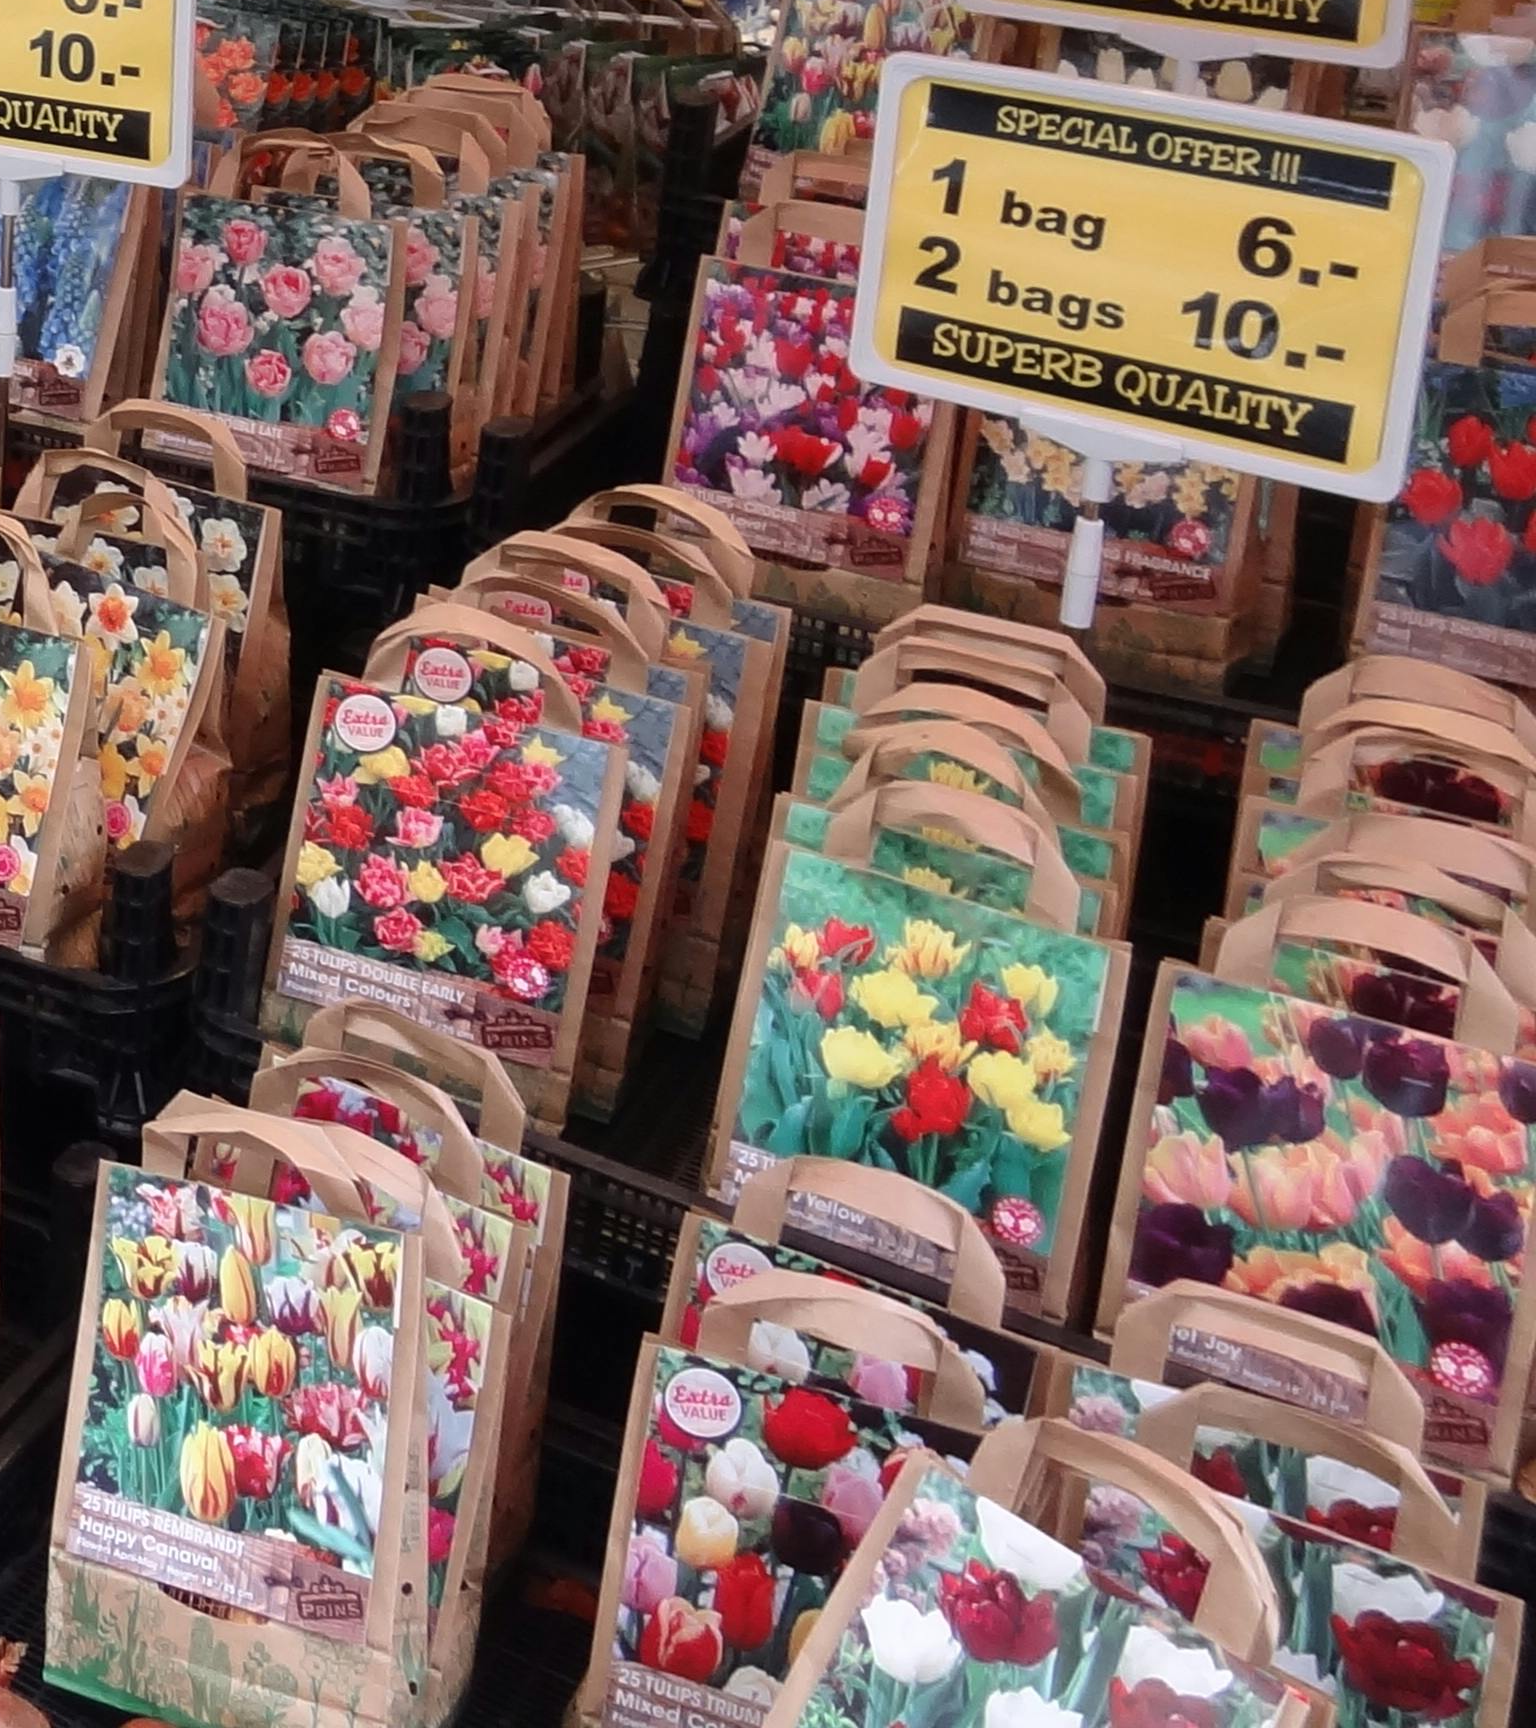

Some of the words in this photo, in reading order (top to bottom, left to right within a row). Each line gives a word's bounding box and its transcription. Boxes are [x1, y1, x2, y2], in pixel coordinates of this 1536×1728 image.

[29, 29, 140, 87] 10.-
[995, 105, 1137, 154] SPECIAL
[1145, 132, 1260, 176] OFFER
[1270, 151, 1301, 183] !!!
[931, 158, 968, 215] 1
[1000, 190, 1107, 251] bag
[1236, 216, 1359, 286] 6.-
[913, 236, 962, 295] 2
[986, 270, 1126, 330] bags
[1180, 291, 1347, 369] 10.-
[932, 324, 1102, 388] SUPERB
[1114, 365, 1313, 438] QUALITY
[417, 662, 465, 680] Extra
[424, 675, 463, 691] VALUE
[341, 709, 389, 727] Extra
[347, 724, 386, 739] VALUE
[288, 960, 342, 990] Mixed
[344, 975, 412, 1010] Colours
[291, 944, 312, 962] 25
[313, 948, 359, 978] TULIPS
[360, 962, 421, 993] DOUBLE
[422, 980, 467, 1006] EARLY
[485, 1031, 551, 1048] PRINS
[737, 1148, 759, 1169] 25
[801, 1194, 866, 1226] Yellow
[1204, 1332, 1242, 1361] Joy
[673, 1384, 734, 1407] Extra
[678, 1402, 728, 1422] VALUE
[81, 1493, 102, 1513] 25
[102, 1499, 151, 1529] TULIPS
[152, 1513, 246, 1558] REMBRANDT
[78, 1514, 139, 1550] Happy
[141, 1532, 219, 1573] Canaval
[301, 1599, 362, 1620] PRINS
[618, 1668, 642, 1687] 25
[645, 1676, 702, 1708] TULIPS
[614, 1689, 680, 1725] Mixed
